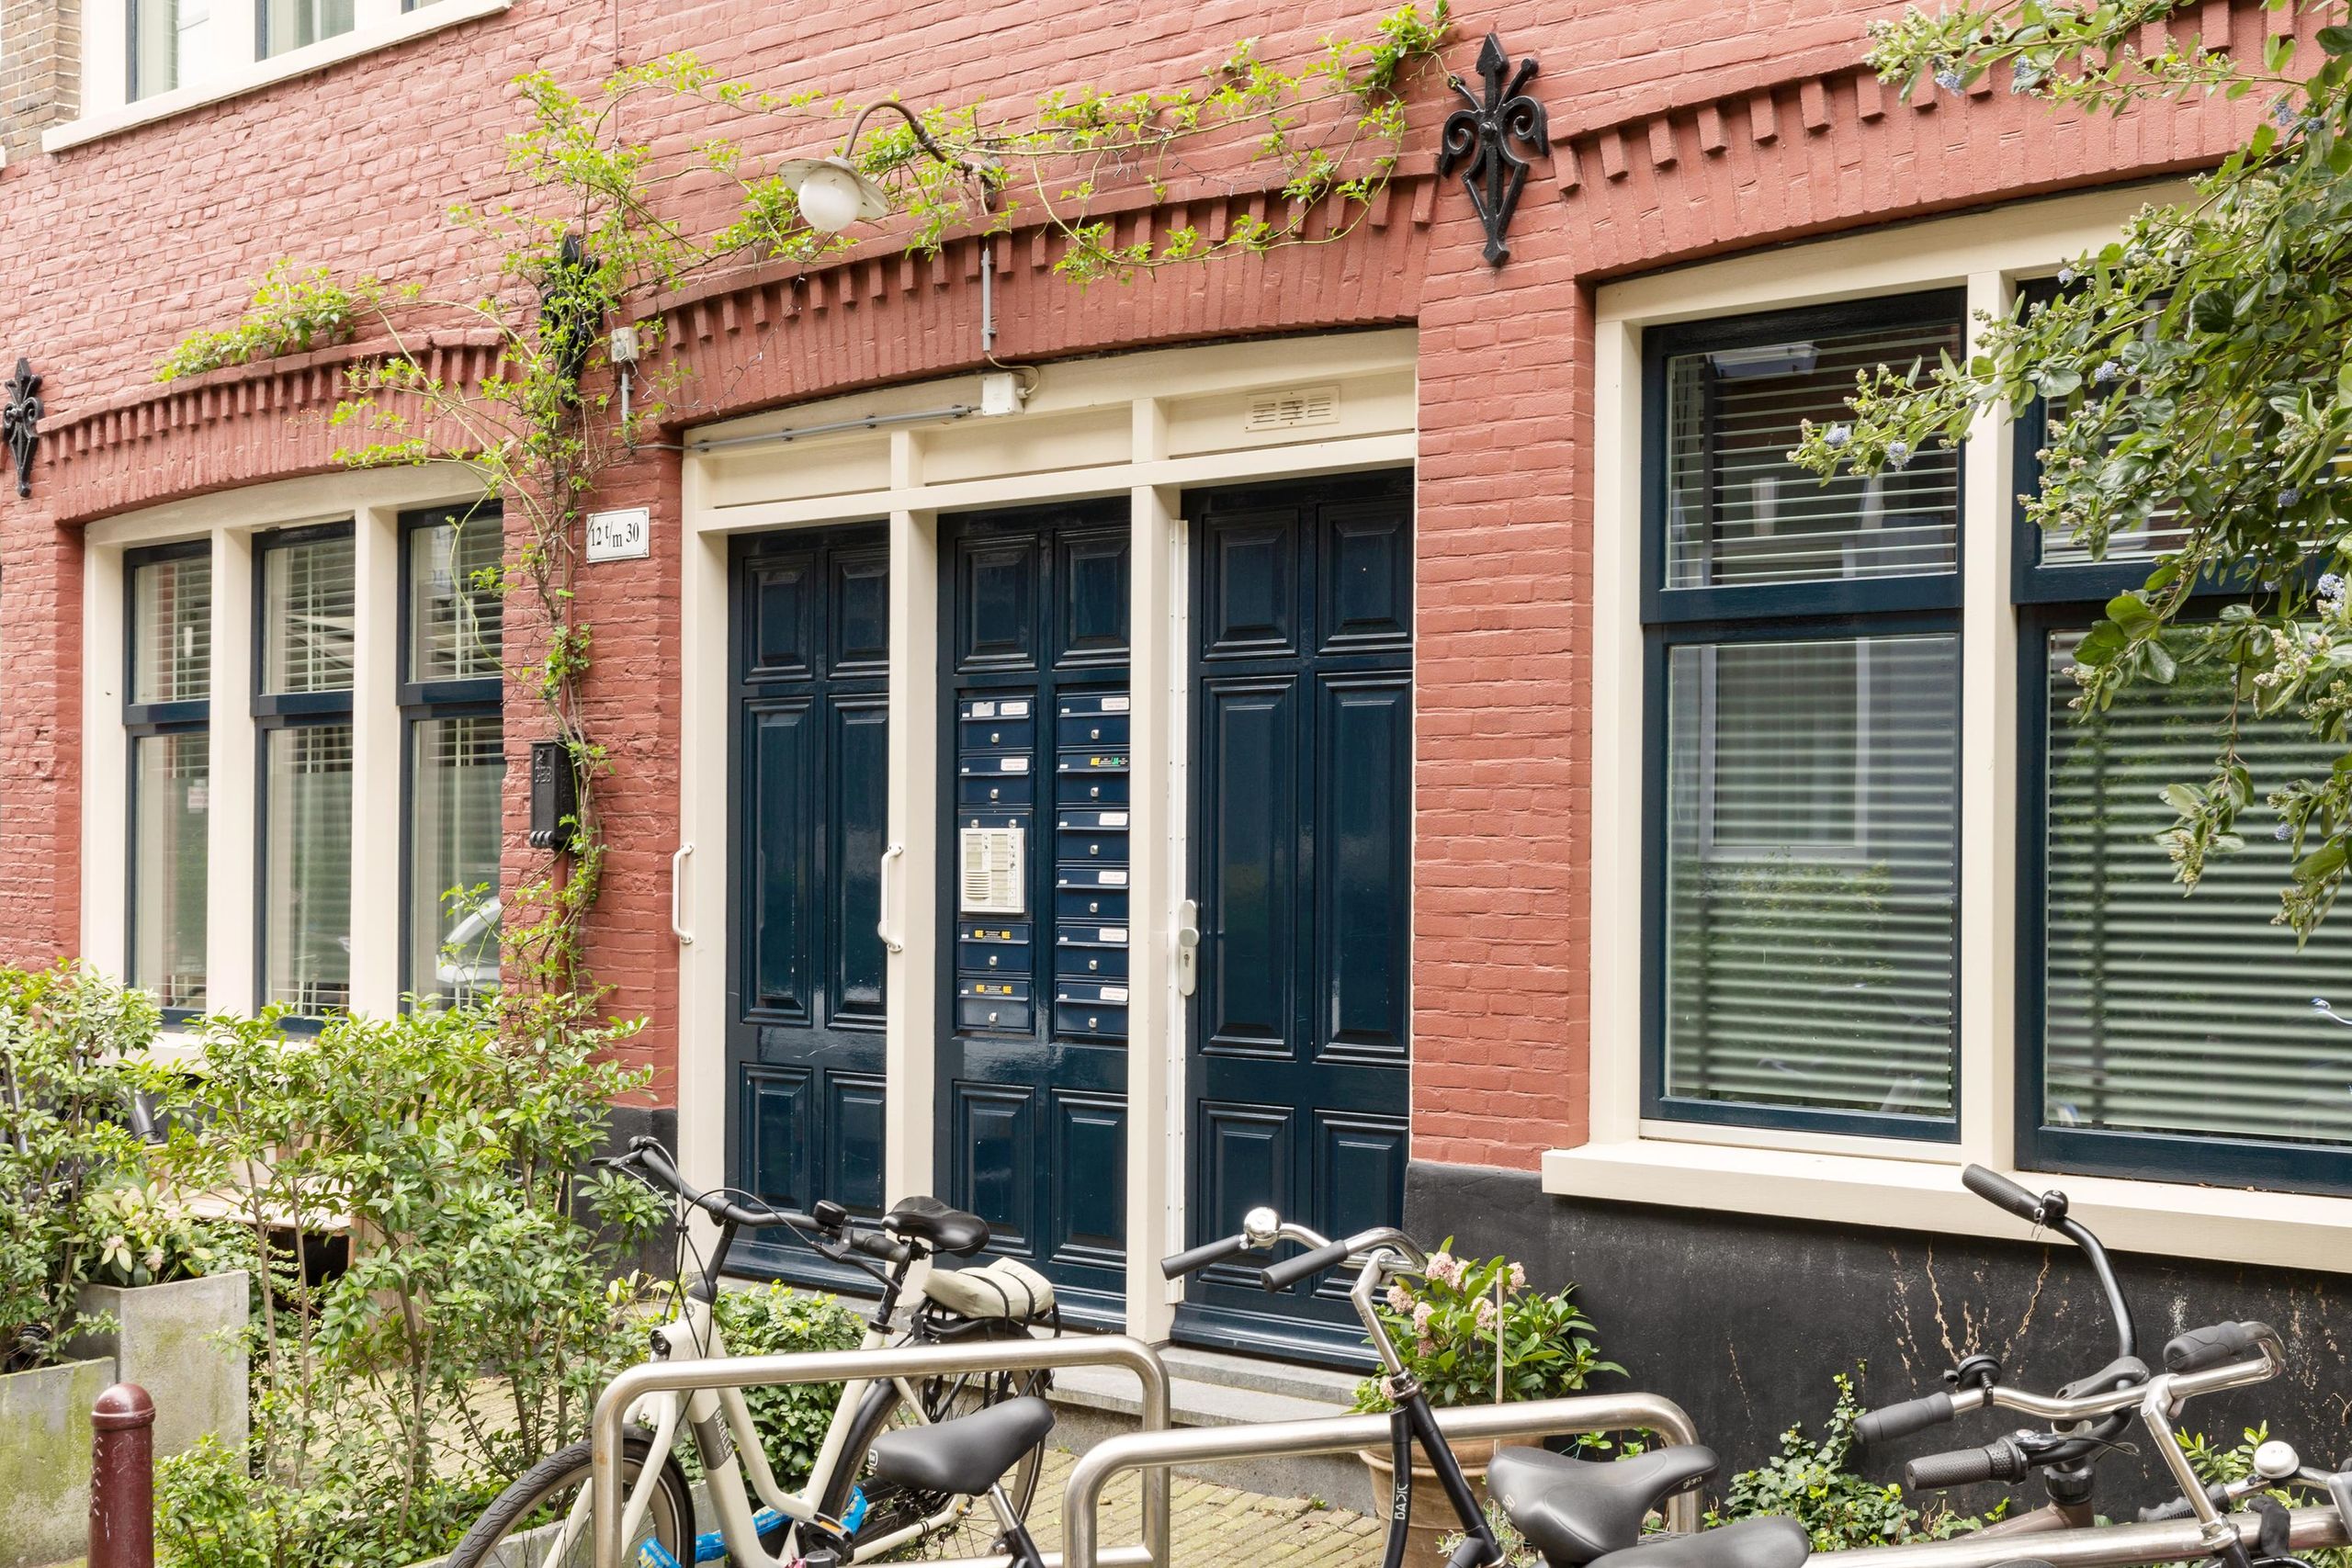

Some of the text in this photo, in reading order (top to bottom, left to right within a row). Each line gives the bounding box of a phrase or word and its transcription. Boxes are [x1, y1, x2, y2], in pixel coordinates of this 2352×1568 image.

[591, 526, 602, 547] 12
[626, 522, 639, 543] 30
[1394, 1482, 1409, 1521] BASIC
